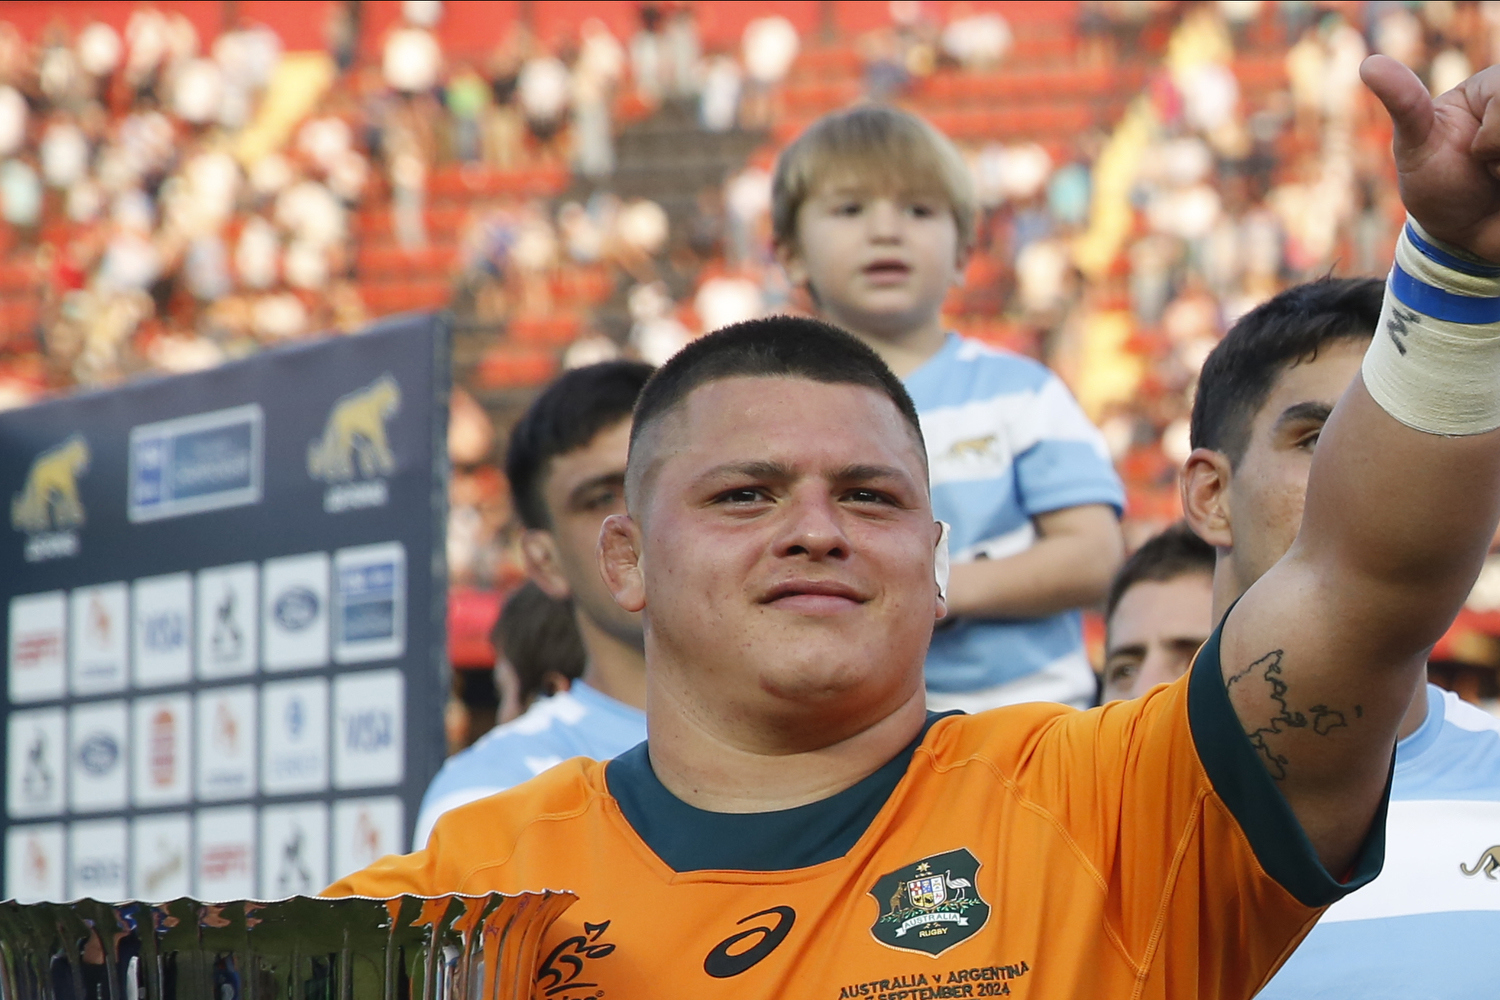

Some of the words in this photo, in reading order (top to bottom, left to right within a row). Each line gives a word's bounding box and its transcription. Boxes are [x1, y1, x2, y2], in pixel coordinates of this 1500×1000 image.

[904, 913, 958, 929] AUSTRALIA
[919, 927, 948, 938] RUGBY
[838, 973, 928, 1000] AUSTRALIA
[947, 961, 1030, 984] ARGENTINA
[978, 982, 1011, 997] 2024
